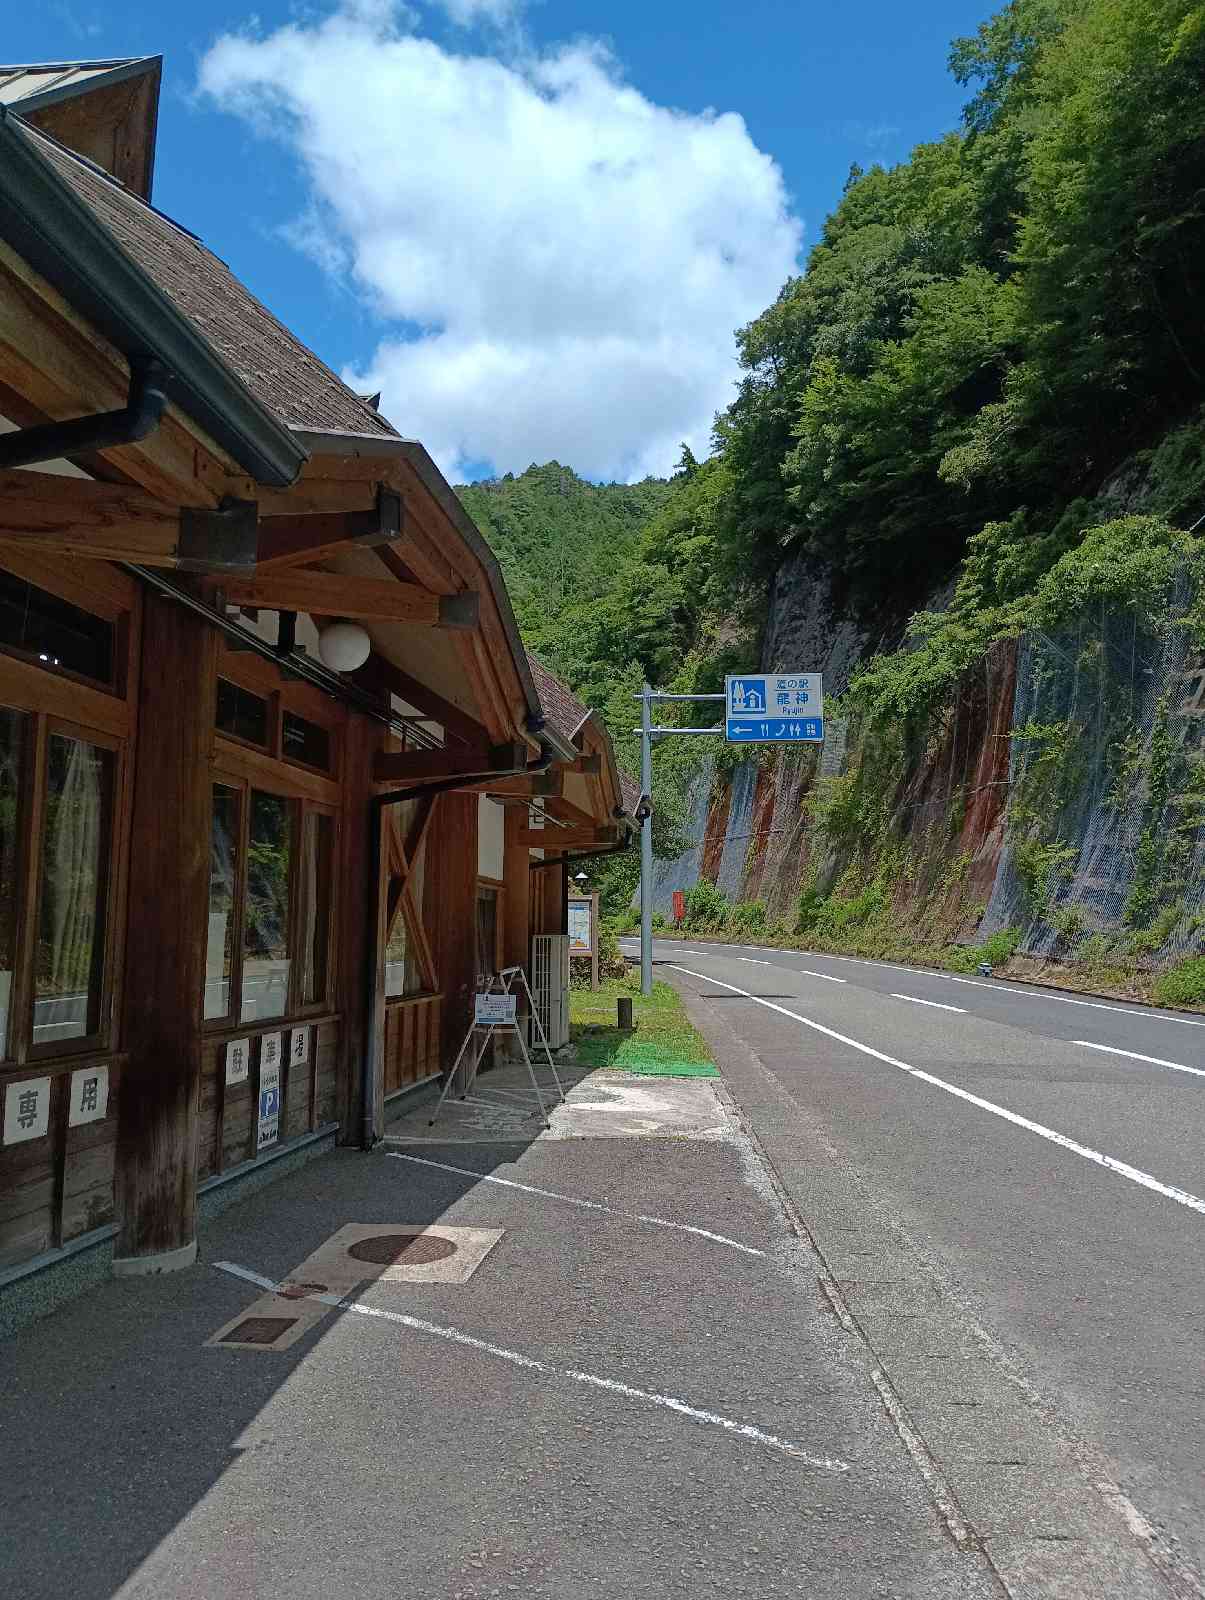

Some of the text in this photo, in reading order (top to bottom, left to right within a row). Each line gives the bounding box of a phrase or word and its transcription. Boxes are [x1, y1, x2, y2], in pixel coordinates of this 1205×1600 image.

[776, 678, 809, 689] 道の駅
[782, 706, 804, 716] Ryujin
